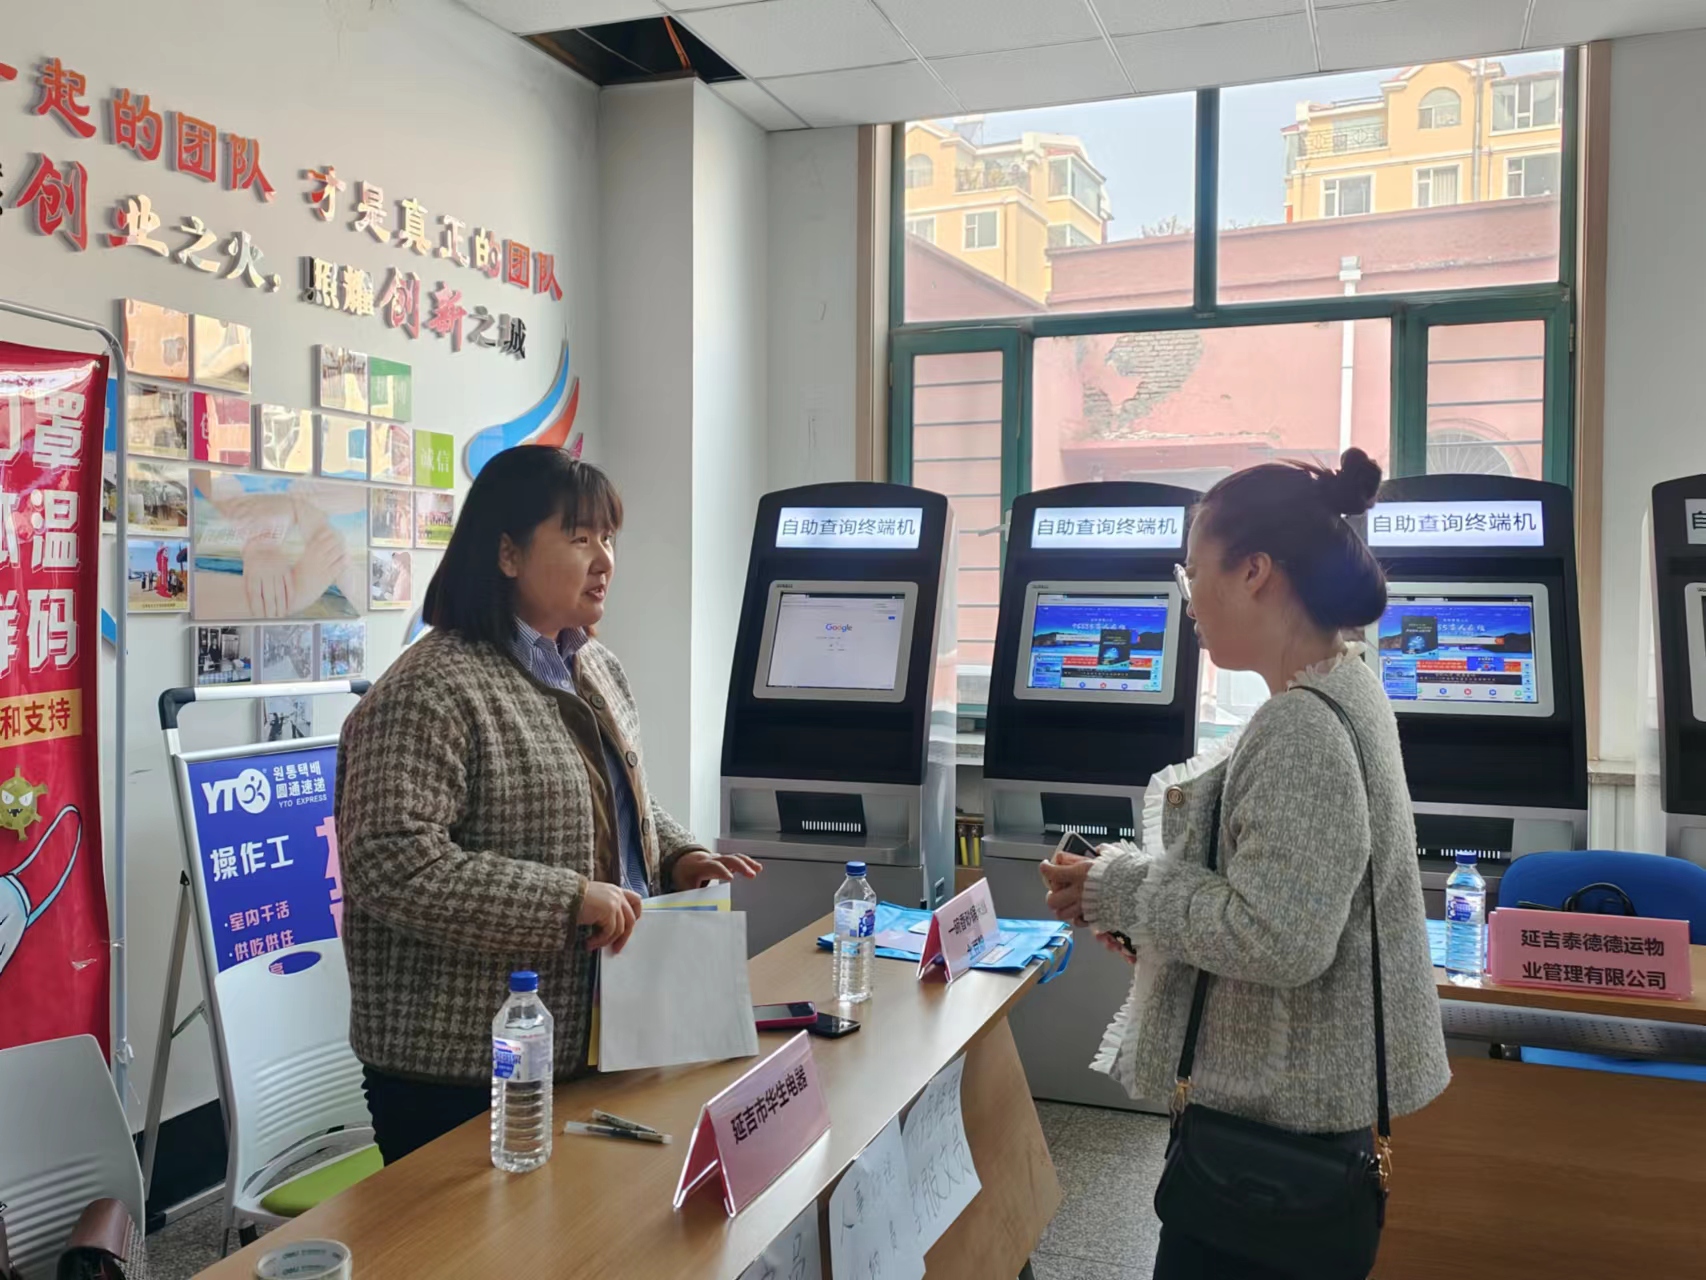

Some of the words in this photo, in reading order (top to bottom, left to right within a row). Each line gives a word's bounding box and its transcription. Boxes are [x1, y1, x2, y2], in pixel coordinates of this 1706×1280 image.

[304, 165, 563, 302] 才是真正的团队
[782, 518, 916, 537] 自助查询终端机
[1037, 517, 1178, 536] 自助查询终端机
[1373, 512, 1537, 534] 自助查询终端机
[825, 623, 853, 632] Google
[0, 697, 71, 740] 和支持
[272, 760, 321, 782] 원통택배
[201, 768, 271, 815] YTO
[279, 800, 293, 809] YTO
[296, 794, 327, 806] EXPRESS
[209, 835, 294, 882] 操作工
[1521, 929, 1664, 957] 延吉泰德德运物
[1522, 960, 1667, 990] 业管理有限公司
[730, 1064, 808, 1145] 延吉市华生电器
